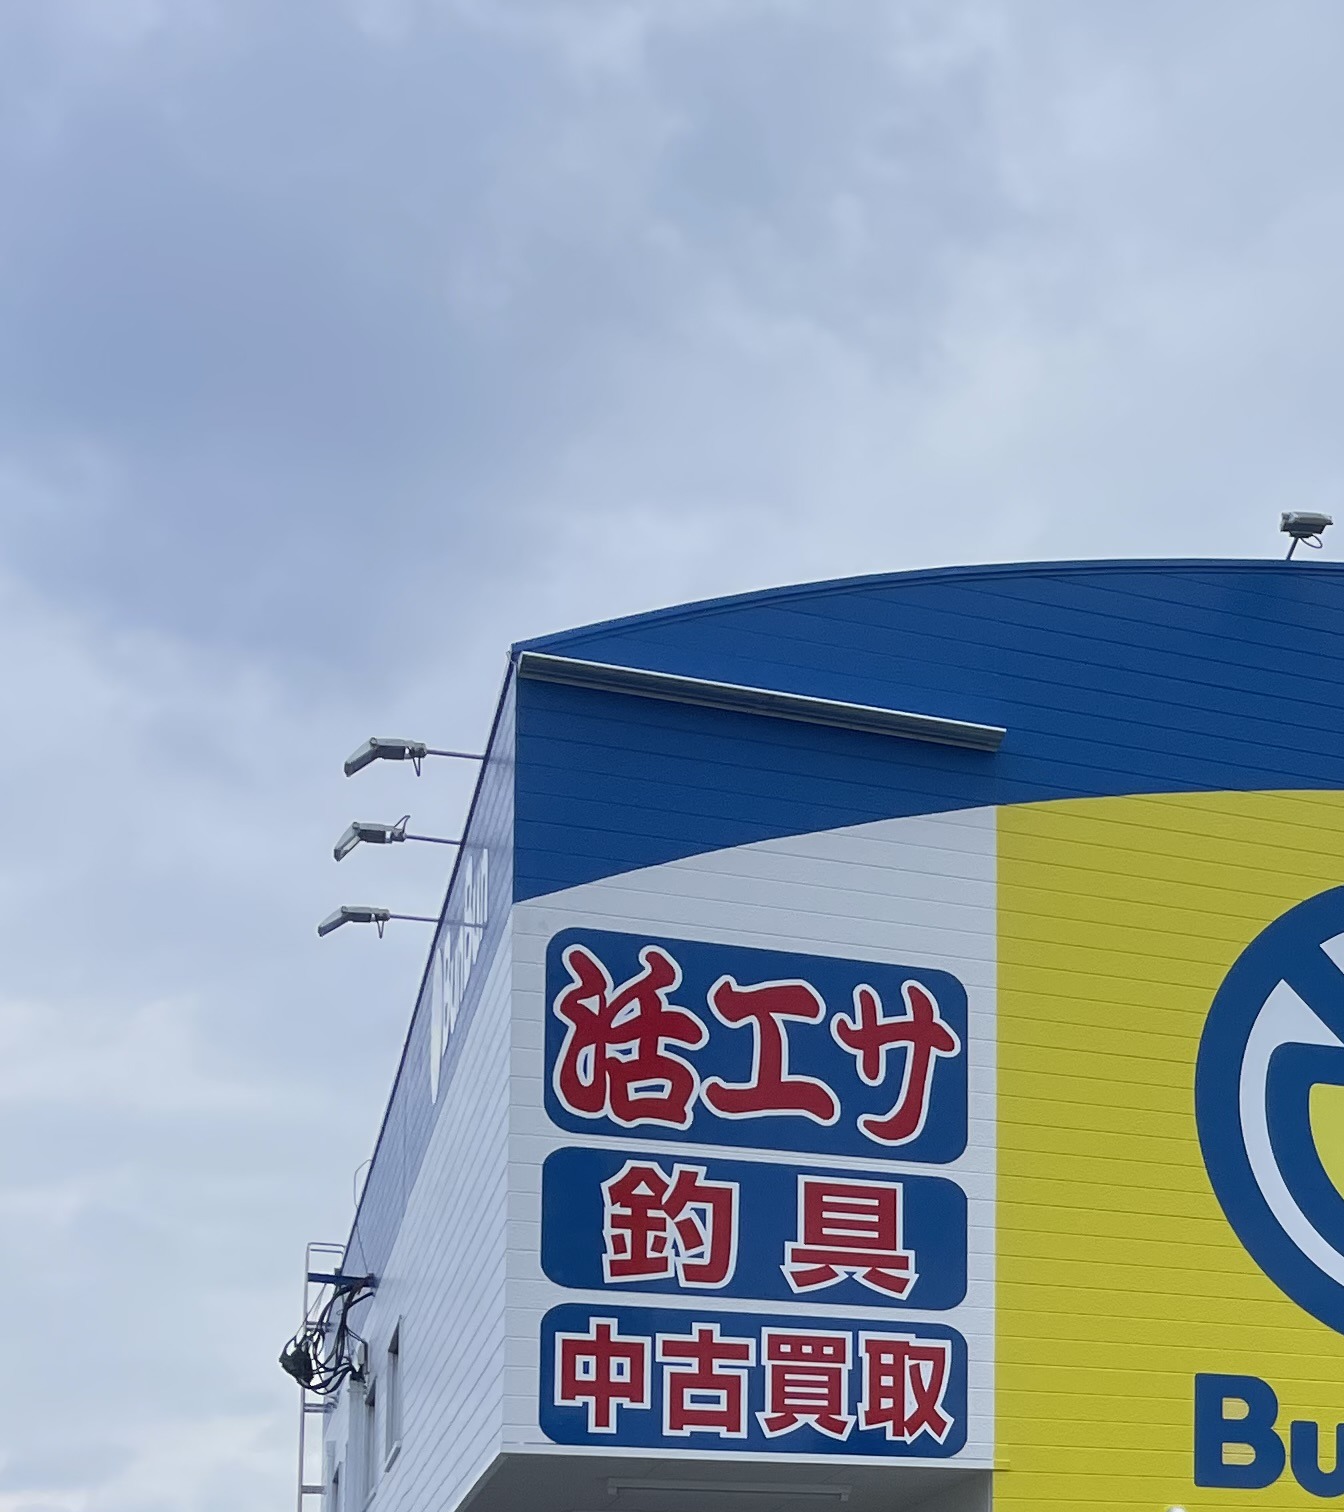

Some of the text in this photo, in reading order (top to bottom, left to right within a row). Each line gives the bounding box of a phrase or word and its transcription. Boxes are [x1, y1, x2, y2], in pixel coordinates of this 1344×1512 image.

[553, 943, 961, 1146] 活エサ
[554, 1316, 955, 1446] 中古買取
